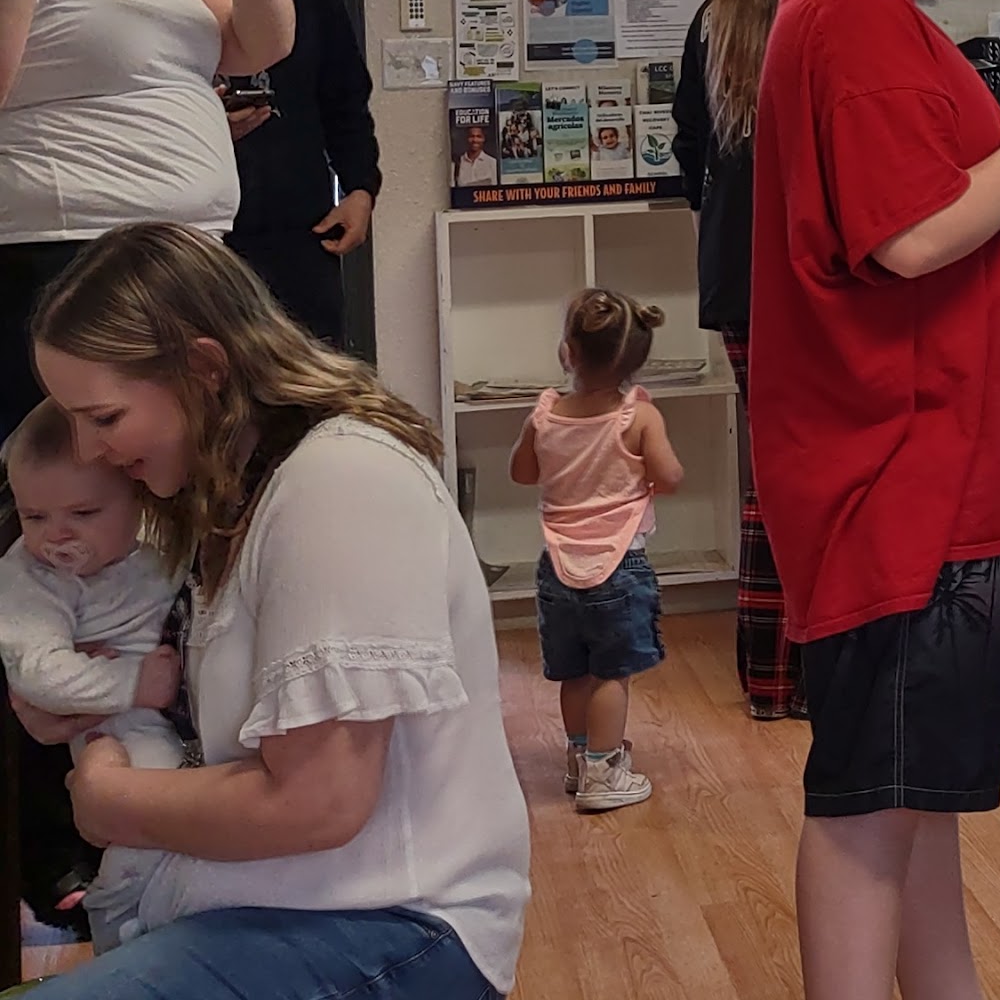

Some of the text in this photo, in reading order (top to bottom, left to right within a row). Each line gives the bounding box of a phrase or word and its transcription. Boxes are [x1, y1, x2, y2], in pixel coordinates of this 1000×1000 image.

[455, 114, 490, 124] FOR LIFE
[473, 181, 656, 202] SHARE WITH YOUR FRIENDS AND FAMILY
